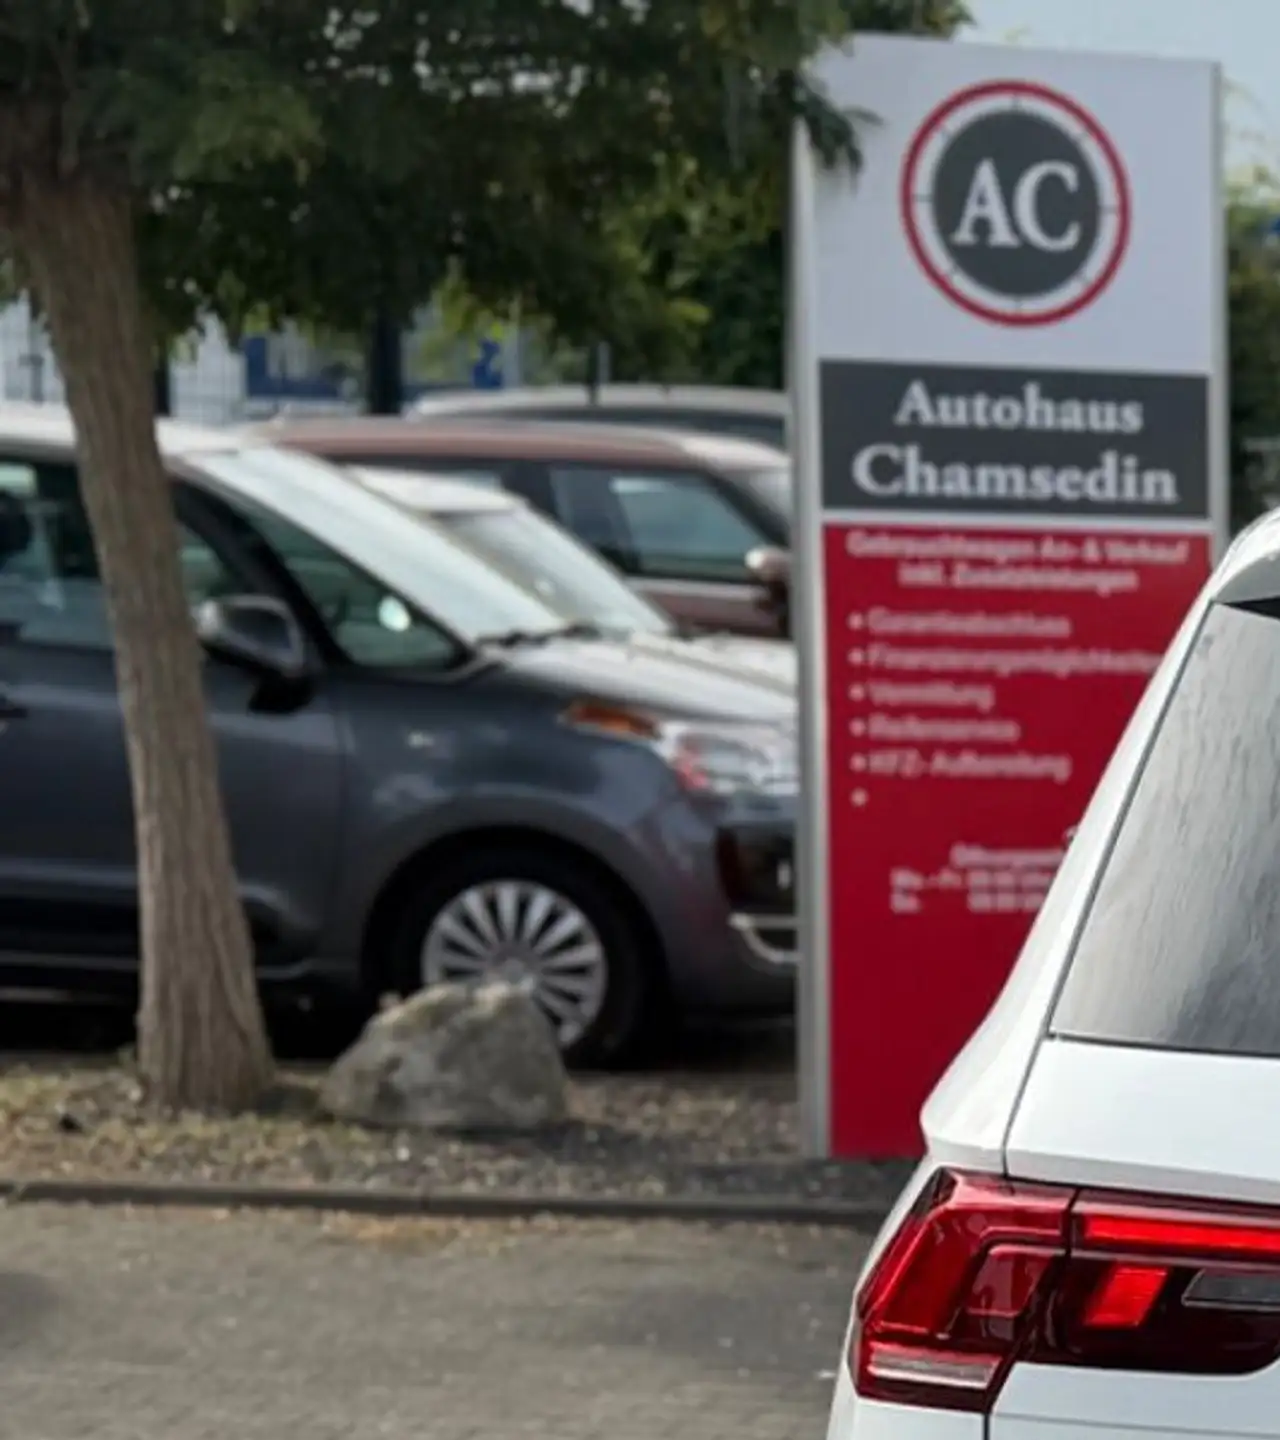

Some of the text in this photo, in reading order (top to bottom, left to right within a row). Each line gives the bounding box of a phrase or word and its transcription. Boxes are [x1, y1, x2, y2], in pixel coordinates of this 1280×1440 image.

[952, 158, 1081, 253] AC
[894, 379, 1144, 435] Autohaus
[851, 443, 1180, 505] Chamsedin
